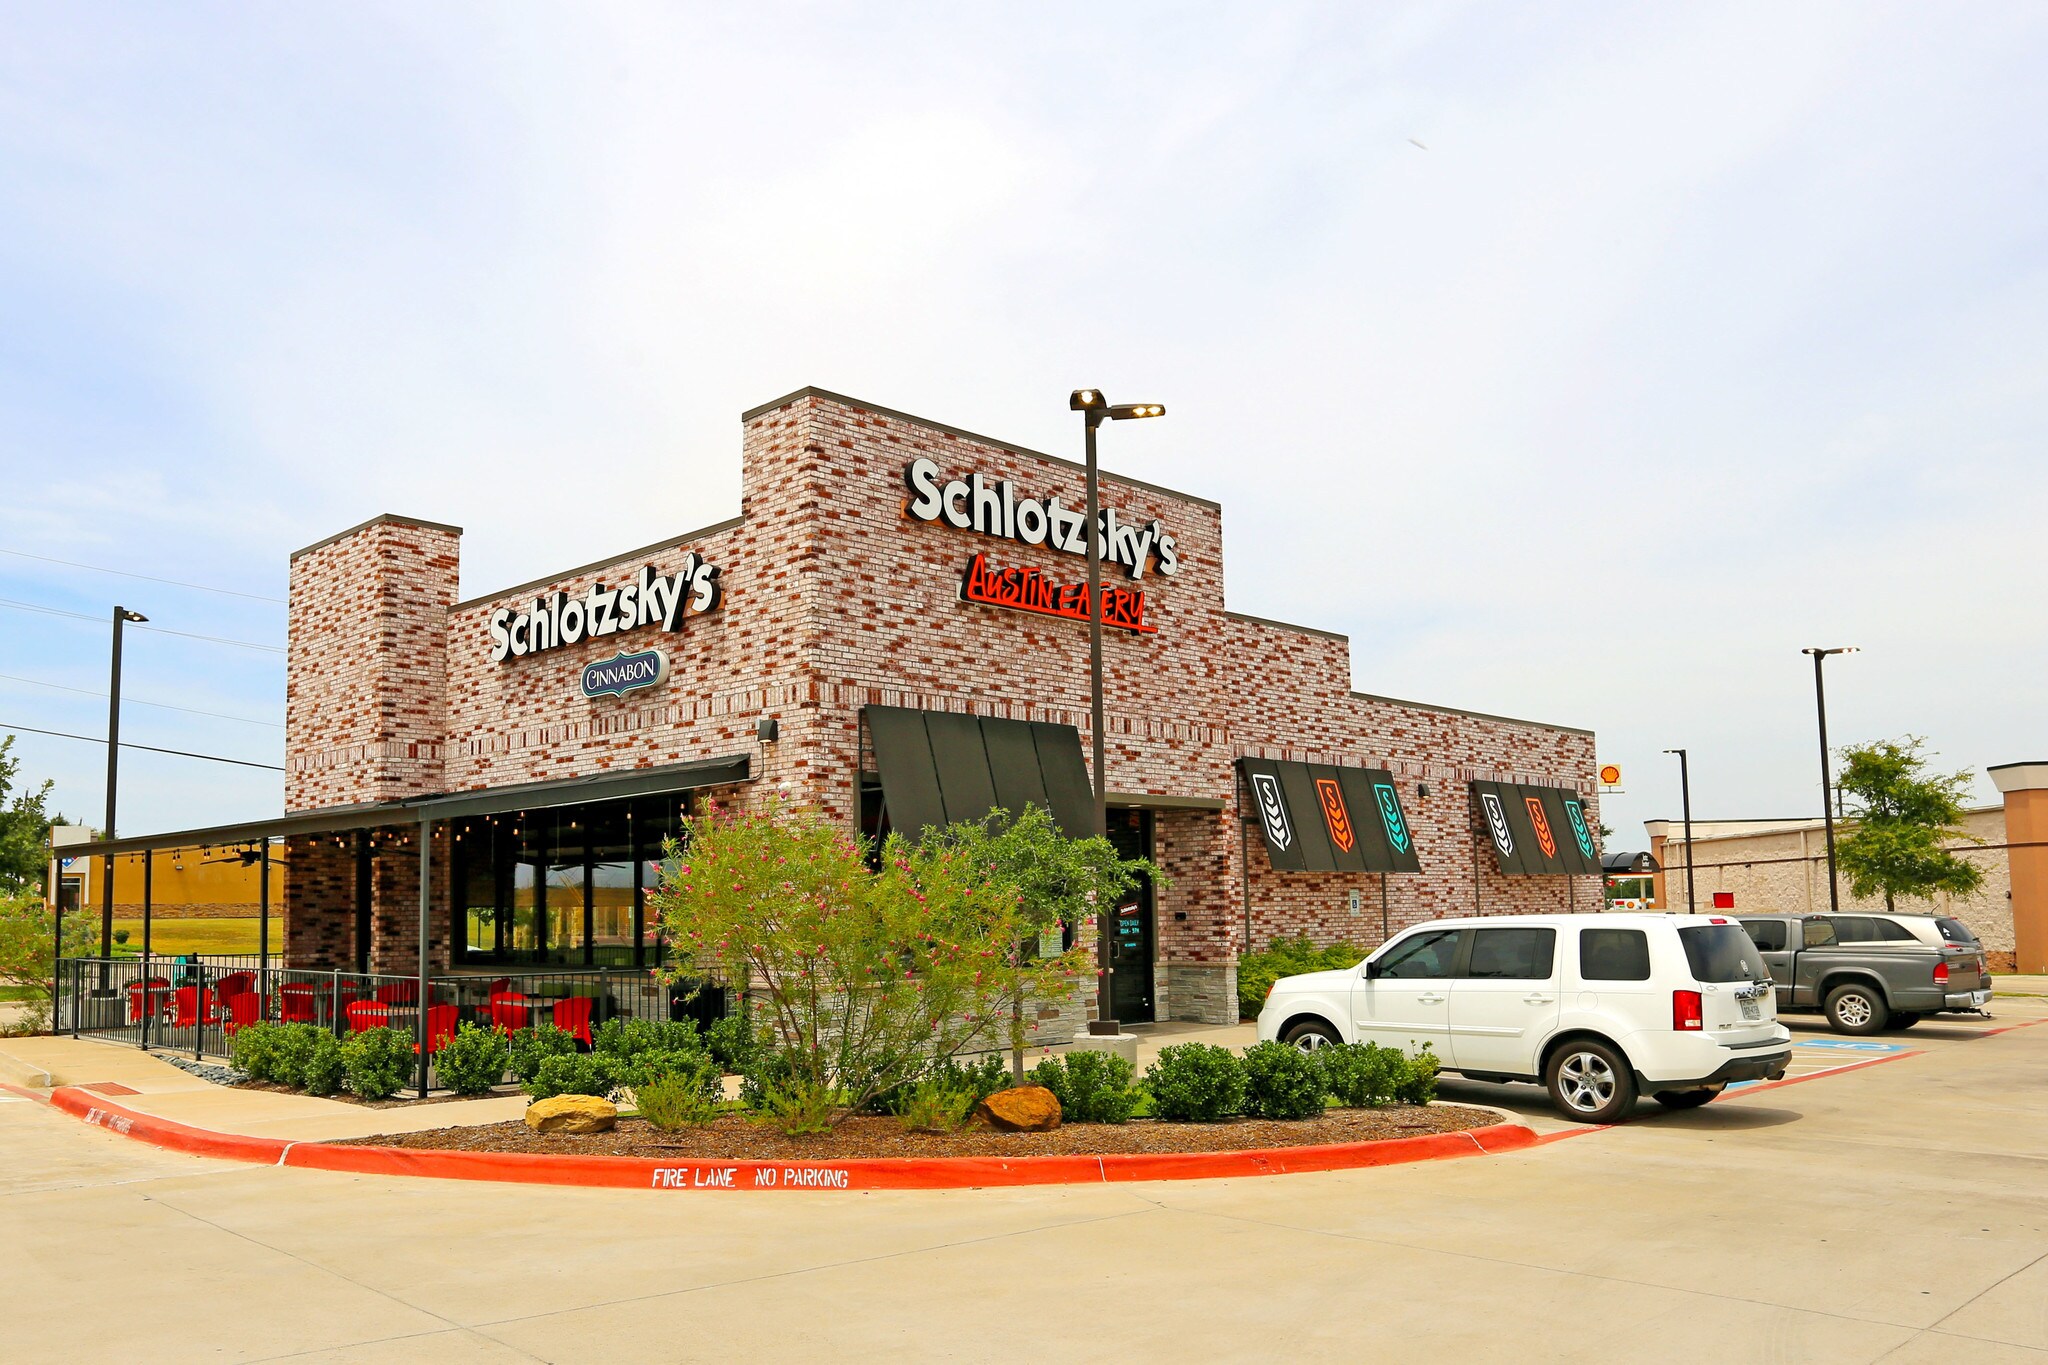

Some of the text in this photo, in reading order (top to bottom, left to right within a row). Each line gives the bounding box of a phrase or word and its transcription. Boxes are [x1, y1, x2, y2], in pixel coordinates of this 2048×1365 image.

[490, 552, 720, 662] Schlotzsky's
[586, 658, 656, 690] CINNABON
[652, 1168, 849, 1189] FIRE LANE NO PARKING
